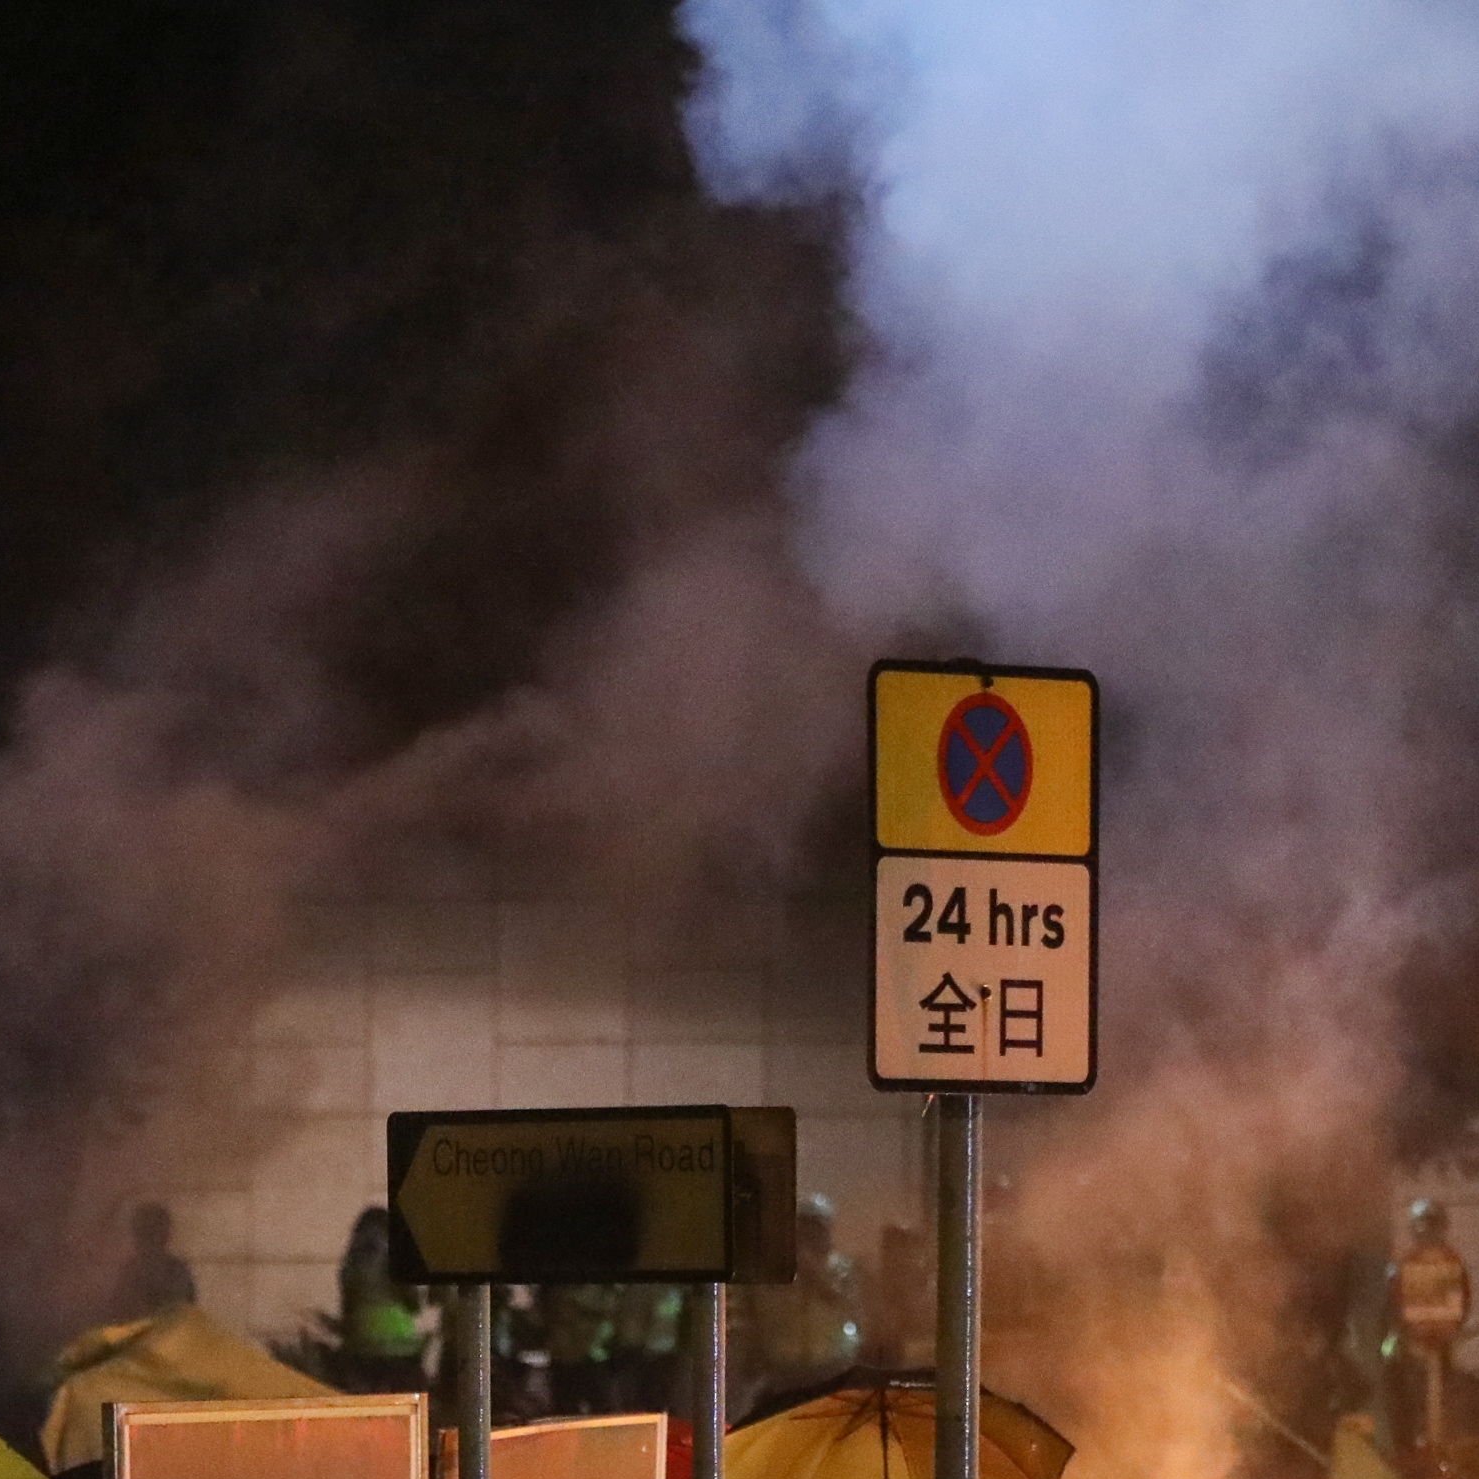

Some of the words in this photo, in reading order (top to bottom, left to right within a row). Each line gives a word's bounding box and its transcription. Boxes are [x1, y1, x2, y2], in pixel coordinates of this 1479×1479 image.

[902, 883, 971, 944] 24
[988, 888, 1065, 949] hrs
[919, 972, 1044, 1057] 全日
[636, 1133, 715, 1173] Road
